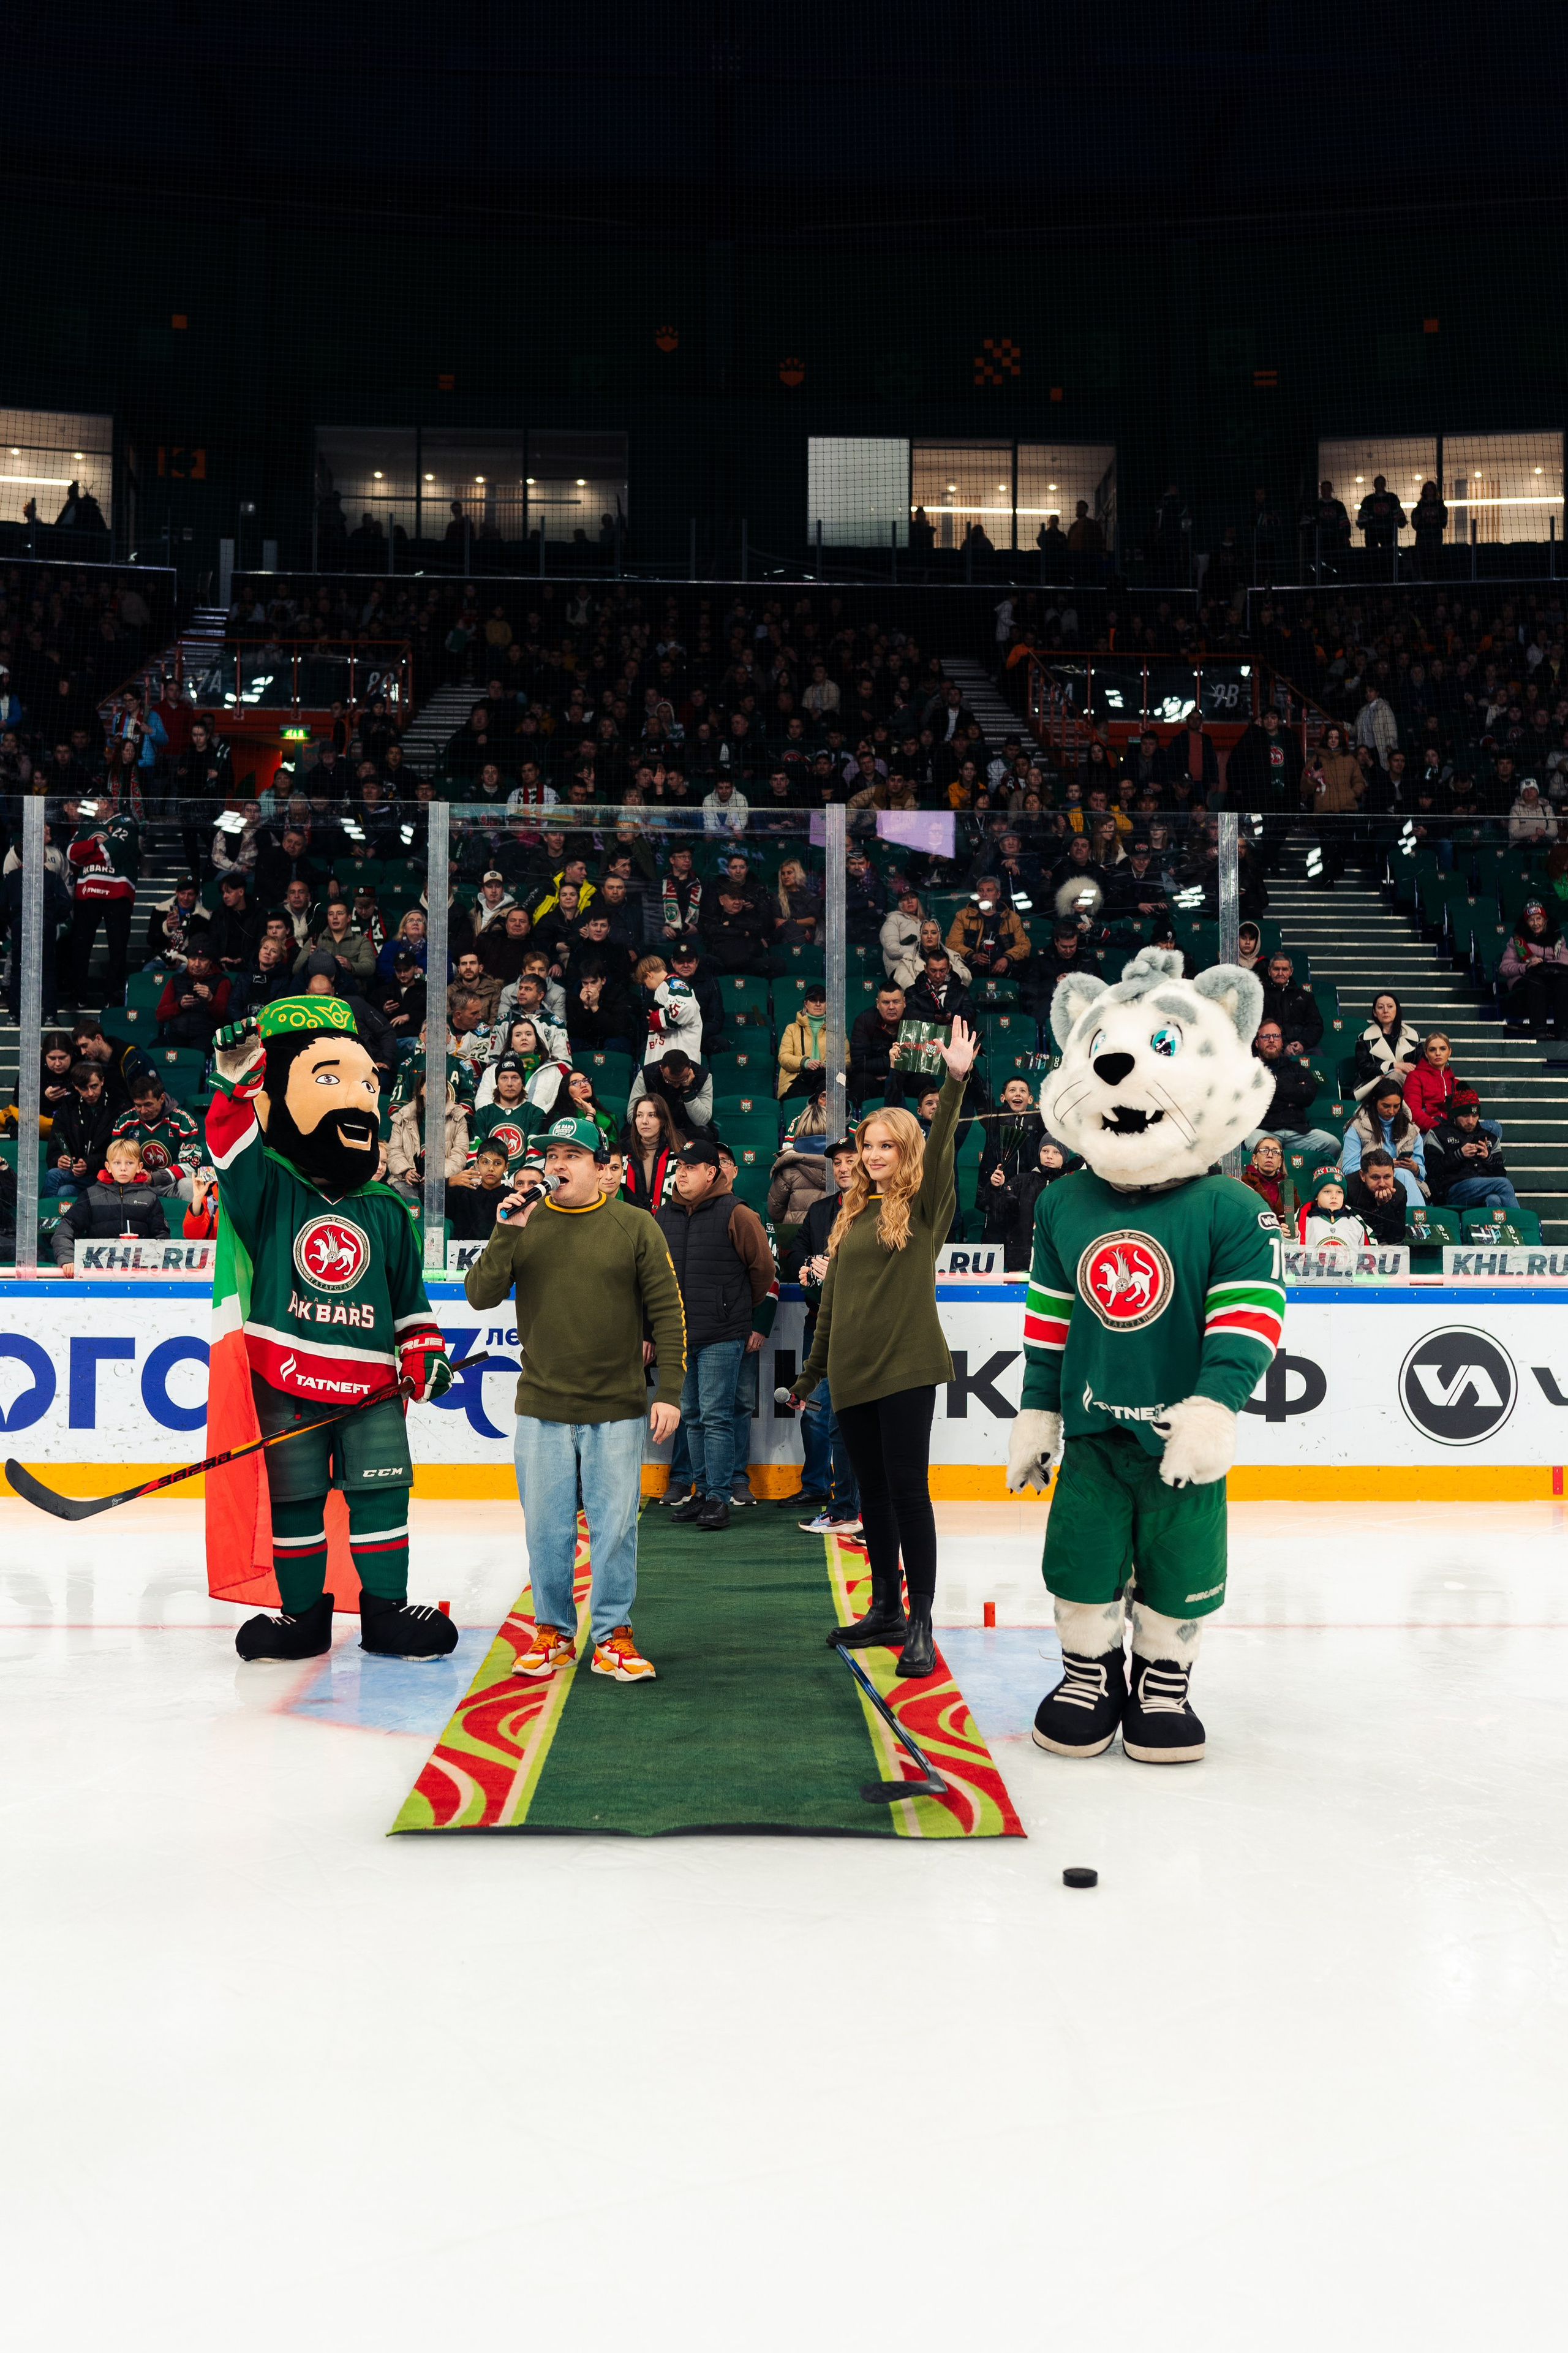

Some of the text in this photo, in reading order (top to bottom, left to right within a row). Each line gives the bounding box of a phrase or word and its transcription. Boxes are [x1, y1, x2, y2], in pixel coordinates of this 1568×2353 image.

[1214, 684, 1238, 708] 9B
[111, 828, 129, 842] 22
[89, 864, 115, 874] BARS
[450, 1070, 459, 1084] A
[83, 1247, 209, 1272] KHL.RU
[1284, 1252, 1401, 1277] KHL.RU
[1452, 1253, 1568, 1278] KHL.RU
[309, 1277, 352, 1291] ТАТАРСТАН
[287, 1290, 375, 1329] AK BARS
[304, 1295, 355, 1307] KAZAN
[399, 1337, 443, 1354] RUE
[295, 1373, 371, 1394] TATNEFT
[363, 1467, 404, 1478] CCM
